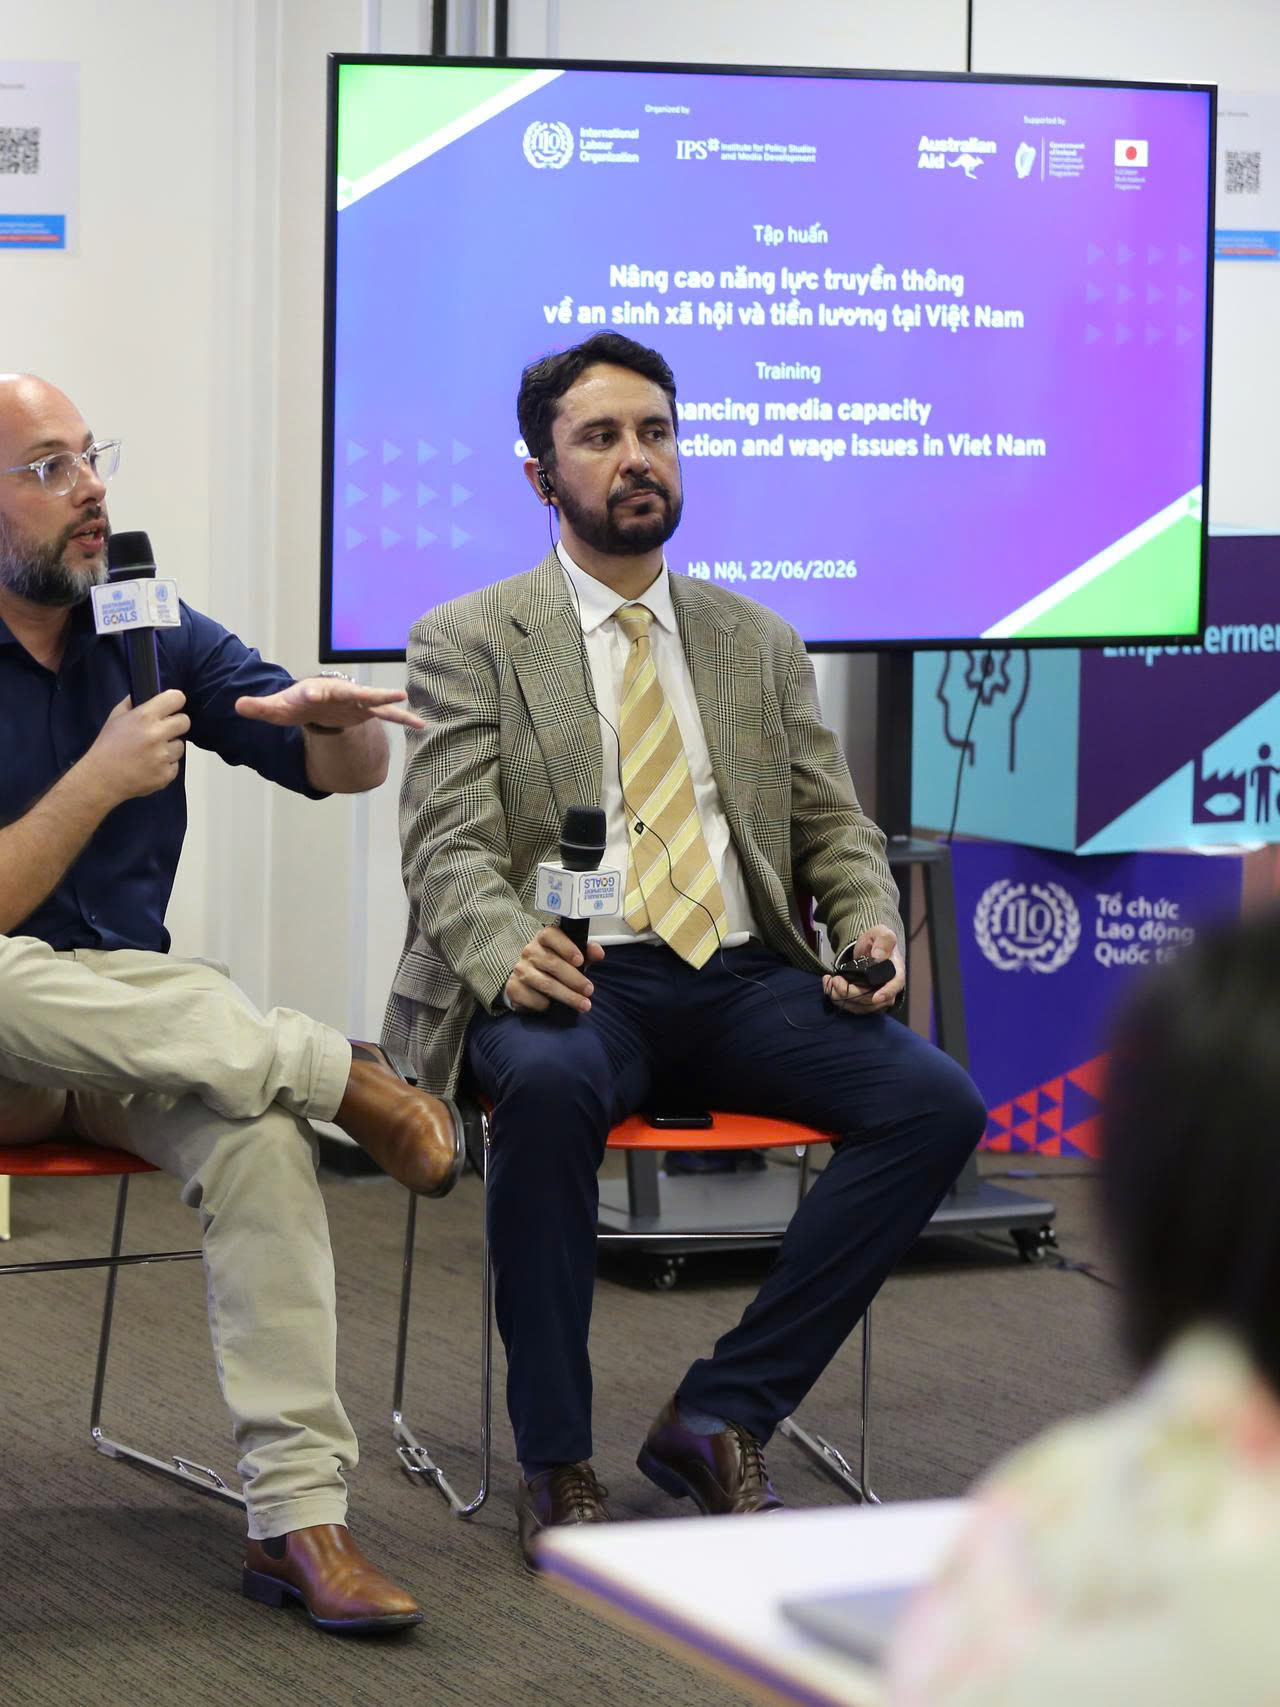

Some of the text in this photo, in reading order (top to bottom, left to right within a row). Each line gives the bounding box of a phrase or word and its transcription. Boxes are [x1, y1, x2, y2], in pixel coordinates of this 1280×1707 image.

[579, 127, 640, 140] International
[579, 139, 614, 151] Labour
[918, 135, 998, 154] Australian
[675, 139, 708, 161] IPS
[721, 152, 737, 161] and
[917, 152, 946, 170] Aid
[753, 221, 829, 246] Tập huấn
[609, 264, 669, 294] Nâng
[673, 269, 716, 289] cao
[720, 265, 776, 295] năng
[780, 266, 820, 296] lực
[901, 268, 965, 297] thông
[576, 304, 607, 324] an
[610, 300, 660, 325] sinh
[664, 300, 694, 325] xã
[698, 301, 733, 331] hội
[737, 301, 766, 326] và
[818, 302, 888, 333] lương
[891, 303, 922, 333] tại
[925, 303, 970, 333] Việt
[974, 304, 1025, 329] Nam
[755, 361, 821, 383] Training
[675, 396, 932, 427] ancing media capacity
[678, 432, 738, 458] ction
[741, 433, 785, 458] and
[788, 439, 847, 464] wage
[851, 433, 919, 458] issues
[922, 433, 944, 458] in
[948, 434, 993, 459] Viet
[997, 435, 1047, 459] Nam
[688, 559, 858, 583] Hà Nội, 22/06/2026
[103, 611, 138, 626] GOALS
[584, 876, 615, 889] GOALS
[1126, 896, 1180, 920] chức
[1006, 898, 1053, 945] ILO
[1095, 917, 1196, 946] Lao động
[1094, 941, 1150, 968] Quốc
